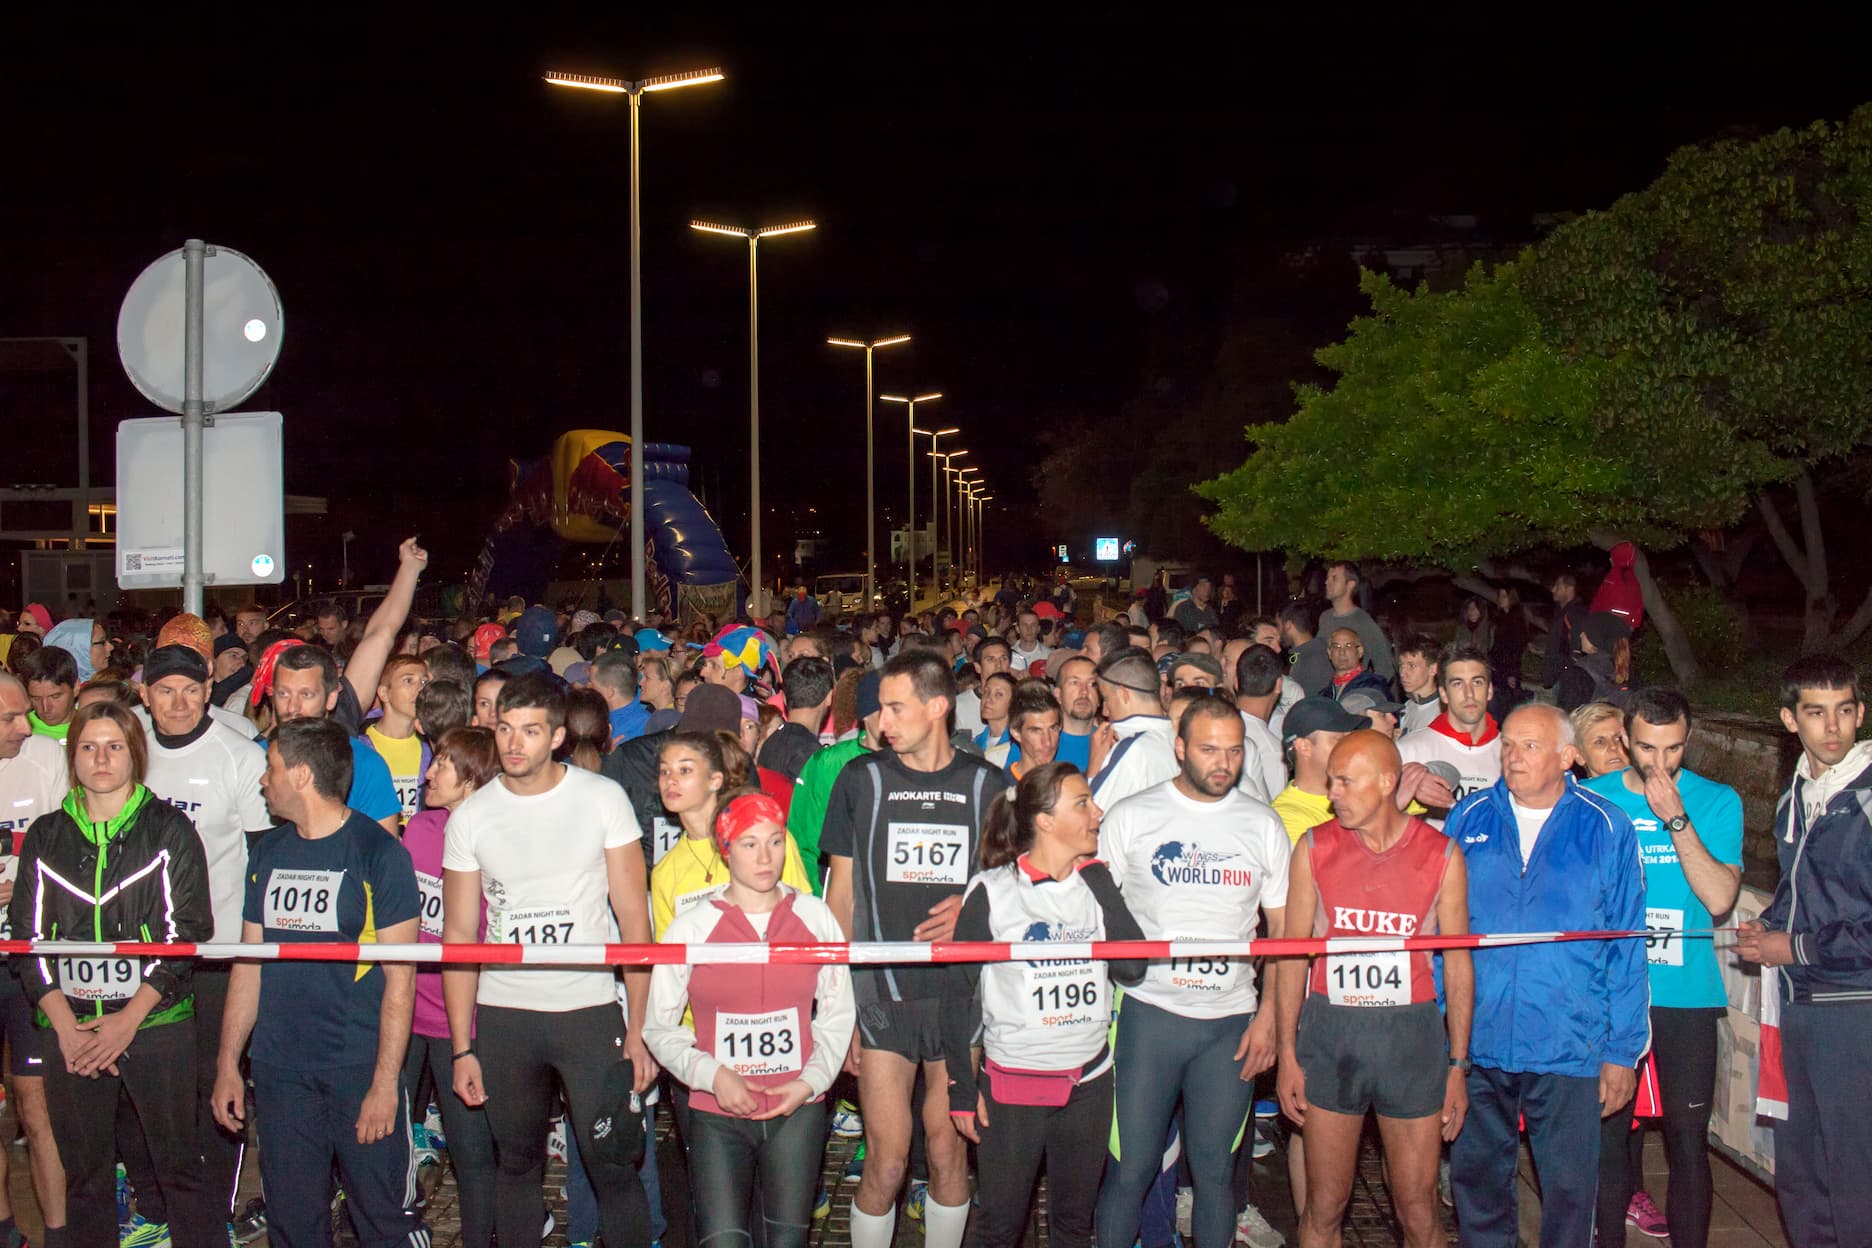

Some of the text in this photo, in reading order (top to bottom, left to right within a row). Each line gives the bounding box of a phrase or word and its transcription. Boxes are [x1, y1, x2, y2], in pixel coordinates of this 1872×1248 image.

[888, 791, 941, 801] AVIOKARTE
[897, 827, 919, 835] ZADAR
[894, 842, 962, 866] 5167
[277, 873, 296, 881] ZADAR
[297, 874, 315, 882] NIGHT
[1168, 866, 1251, 887] WORLD RUN
[270, 886, 329, 913] 1018
[534, 911, 554, 919] NIGHT
[1333, 906, 1417, 937] KUKE
[509, 922, 575, 944] 1187
[63, 957, 133, 984] 1019
[1171, 956, 1230, 976] 1153
[1033, 972, 1056, 980] ZADAR
[1058, 969, 1078, 977] NIGHT
[1172, 977, 1204, 988] sport
[1333, 964, 1402, 990] 1104
[1032, 981, 1097, 1010] 1196
[1343, 994, 1375, 1005] sport
[725, 1017, 749, 1026] ZADAR
[750, 1017, 773, 1025] NIGHT
[1041, 1013, 1073, 1026] sport
[723, 1029, 793, 1058] 1183
[734, 1061, 768, 1074] sport
